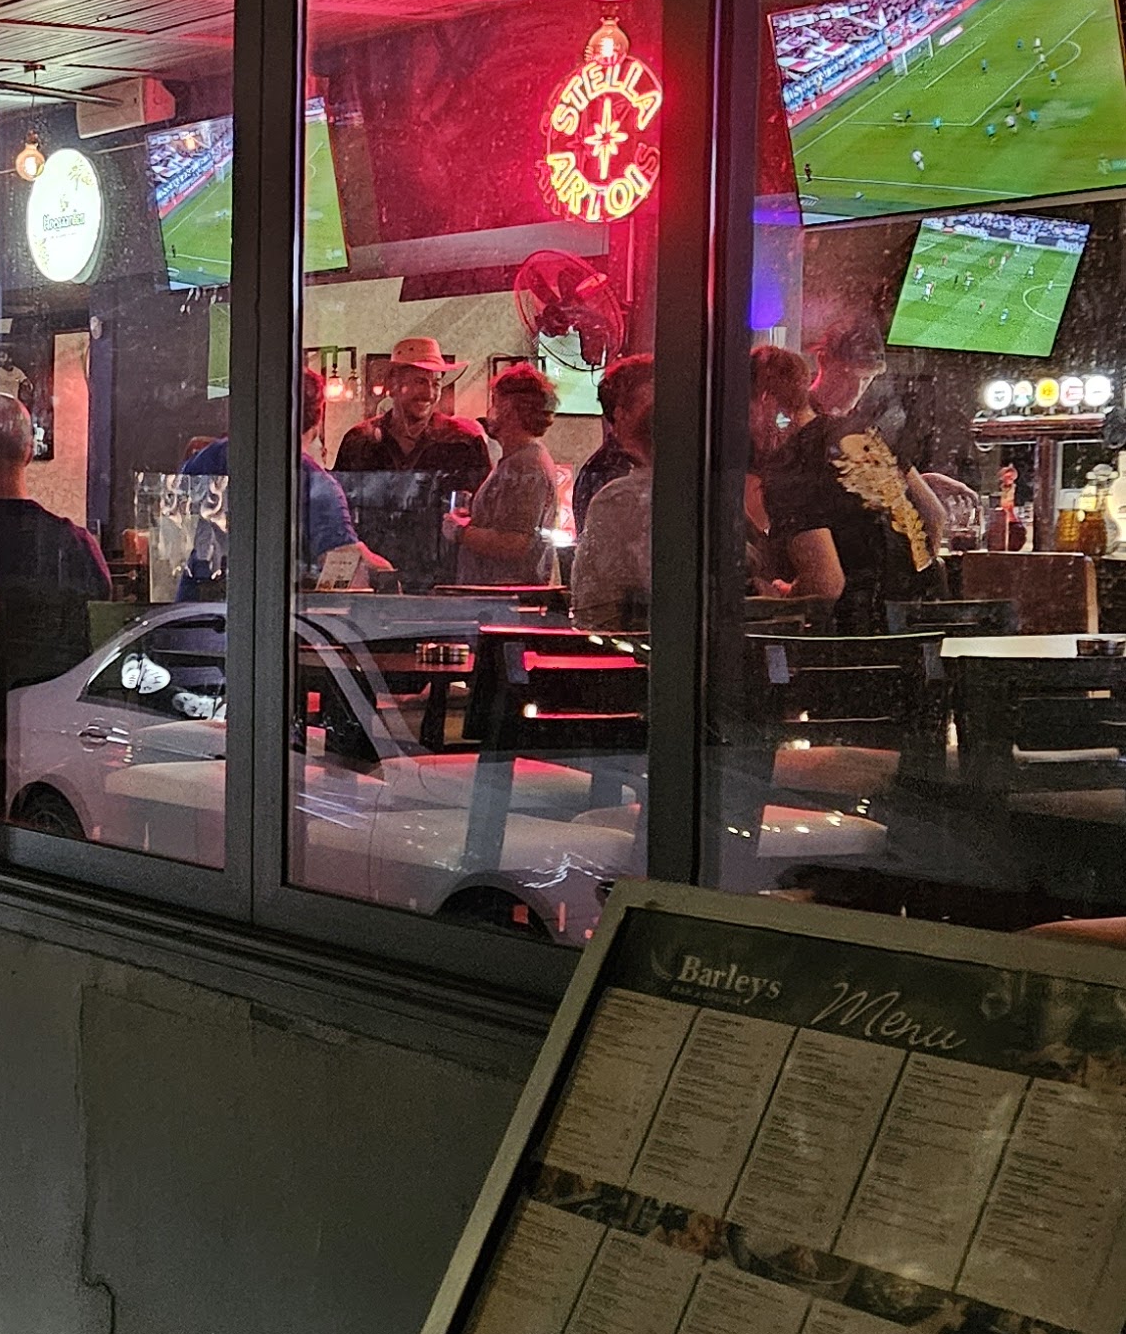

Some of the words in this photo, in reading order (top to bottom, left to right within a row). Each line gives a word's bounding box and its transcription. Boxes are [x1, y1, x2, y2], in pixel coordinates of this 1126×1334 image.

[551, 60, 662, 135] STELLA
[547, 143, 661, 221] ARTOIS
[678, 955, 782, 1005] Barleys
[811, 982, 967, 1049] Menu
